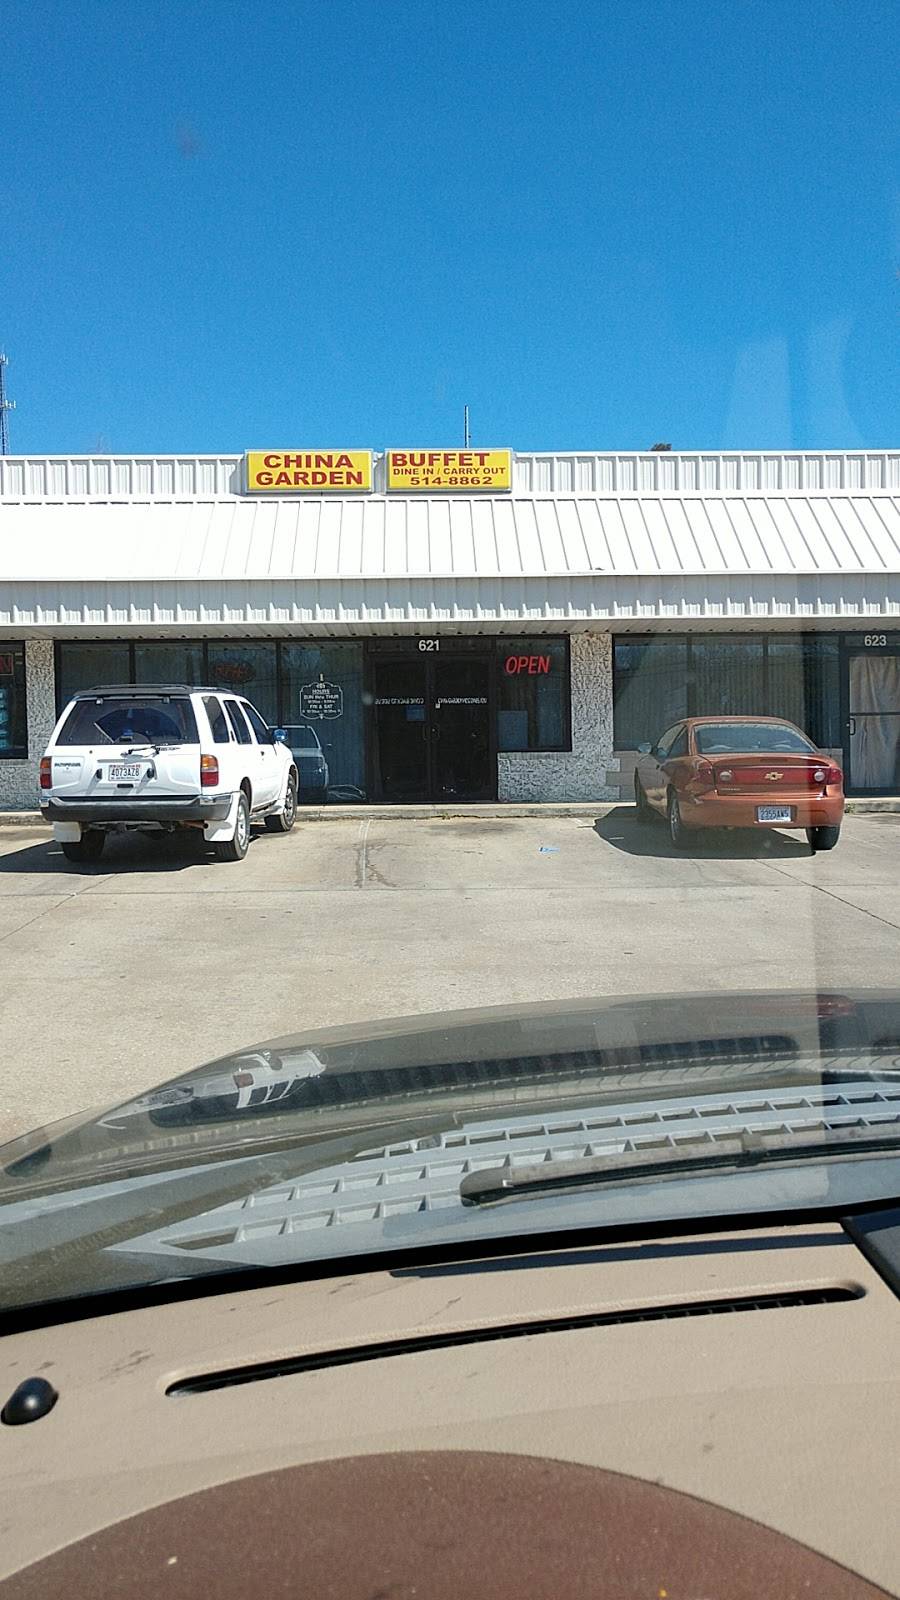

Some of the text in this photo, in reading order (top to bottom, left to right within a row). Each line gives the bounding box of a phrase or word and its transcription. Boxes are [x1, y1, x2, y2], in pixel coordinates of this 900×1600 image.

[264, 454, 353, 468] CHINA
[392, 453, 490, 467] BUFFET
[256, 471, 363, 485] GARDEN
[393, 468, 420, 476] DINE
[422, 467, 434, 475] IN
[443, 467, 480, 475] CARRY
[483, 467, 506, 475] OUT
[410, 476, 493, 486] 514-8862
[418, 639, 440, 652] 621
[864, 634, 887, 647] 623
[504, 655, 551, 675] OPEN
